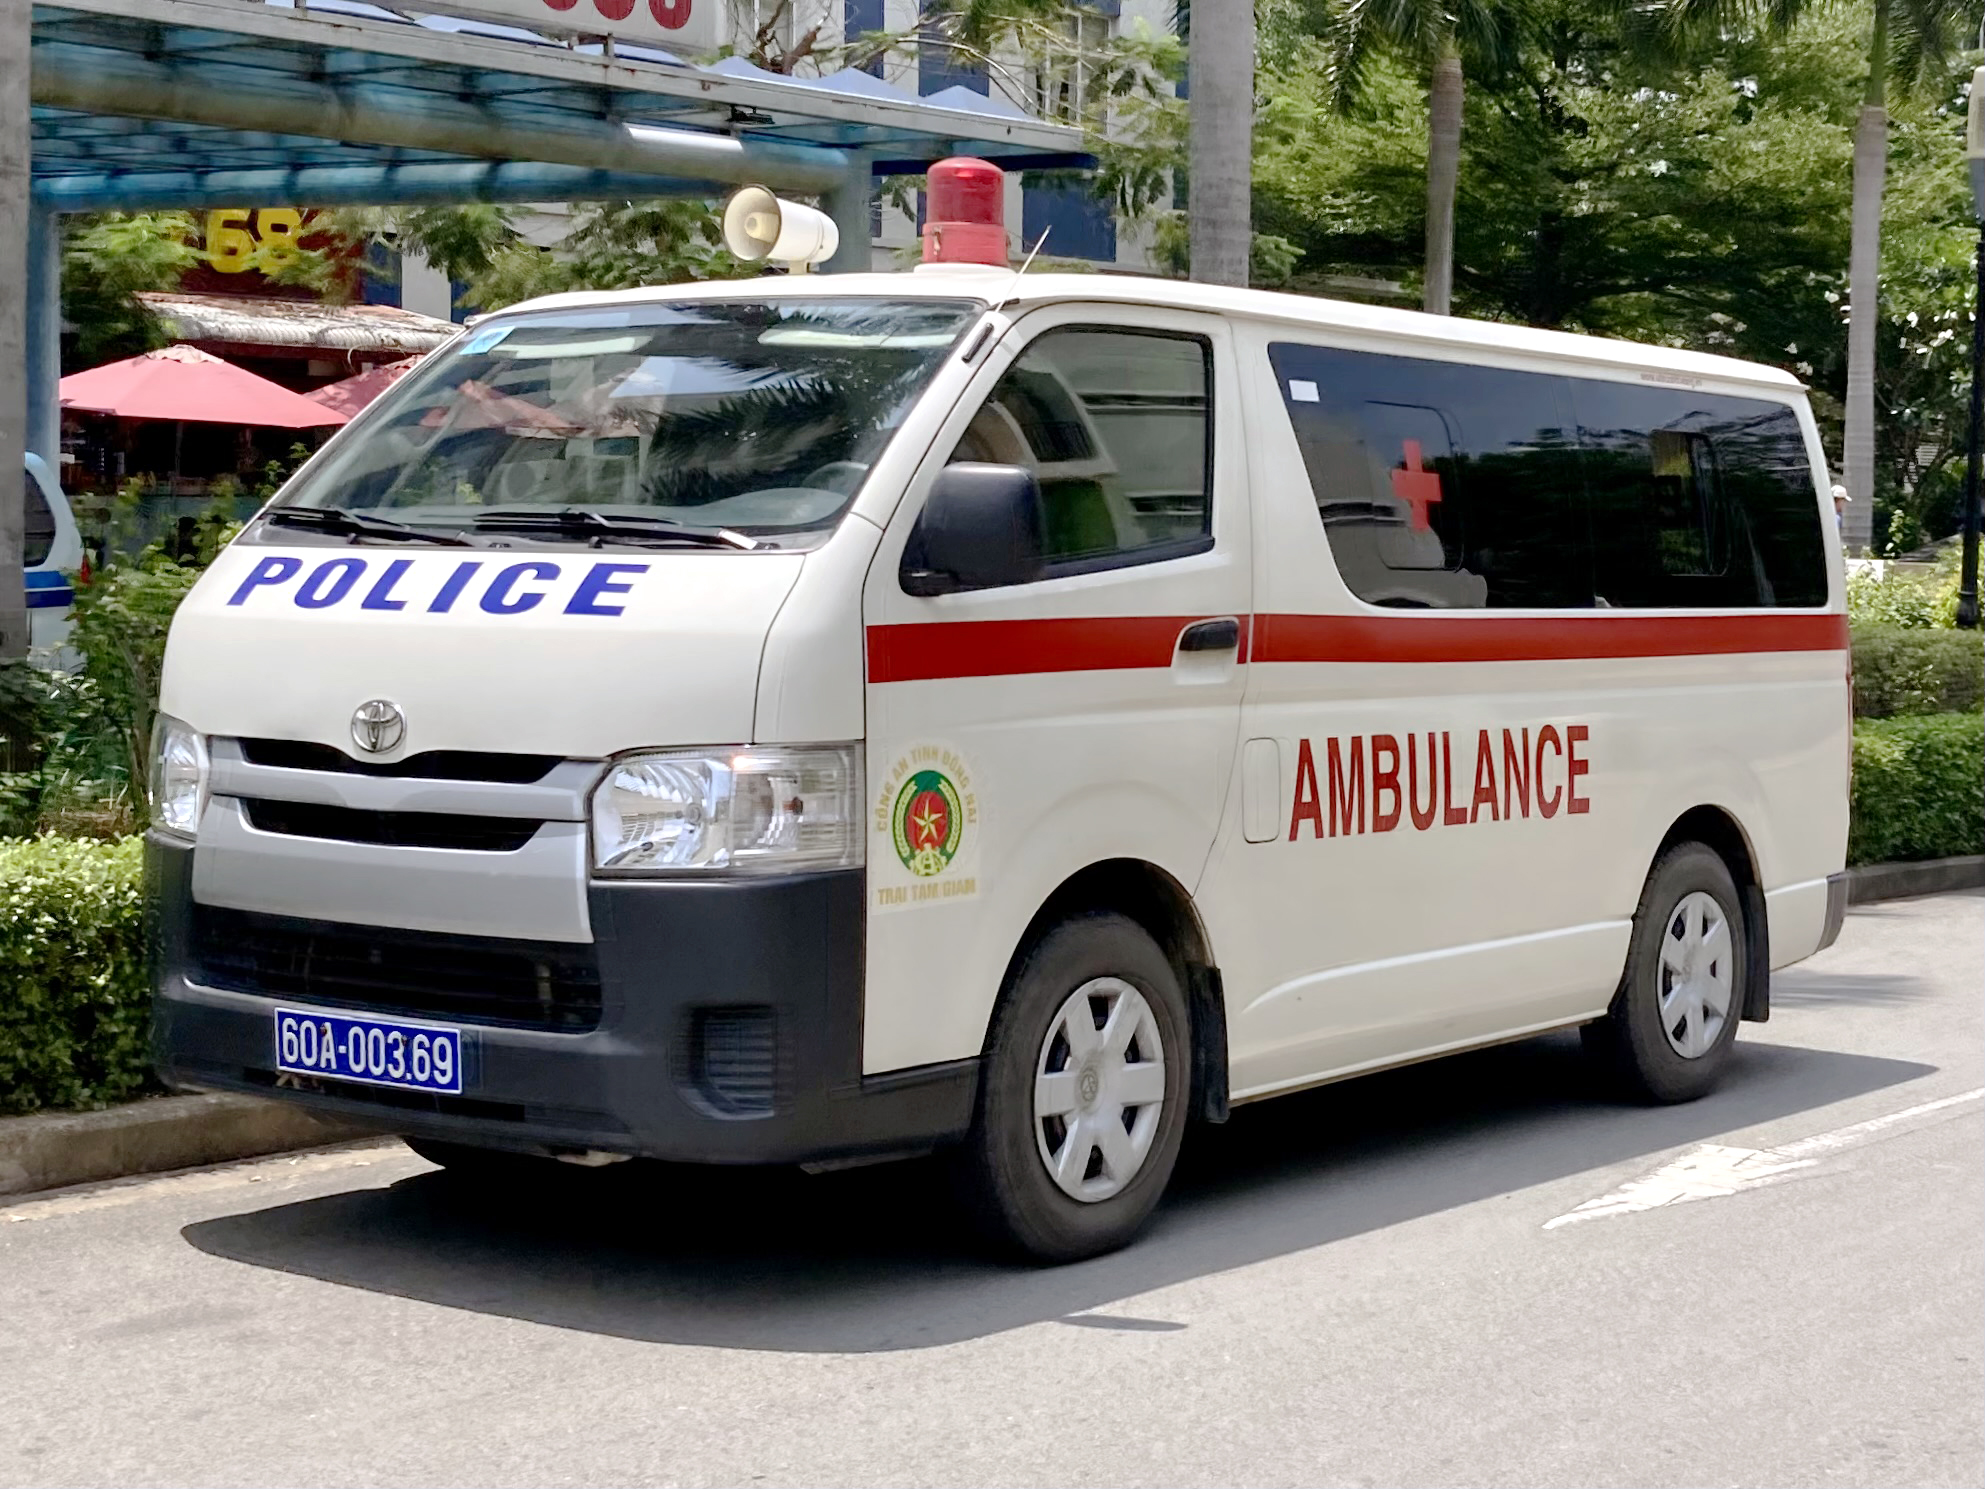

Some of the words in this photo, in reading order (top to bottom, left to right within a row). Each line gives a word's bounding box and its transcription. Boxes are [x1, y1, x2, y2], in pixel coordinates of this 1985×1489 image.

[226, 556, 652, 617] POLICE
[1288, 724, 1590, 842] AMBULANCE
[282, 1017, 454, 1085] 60A-003.69
